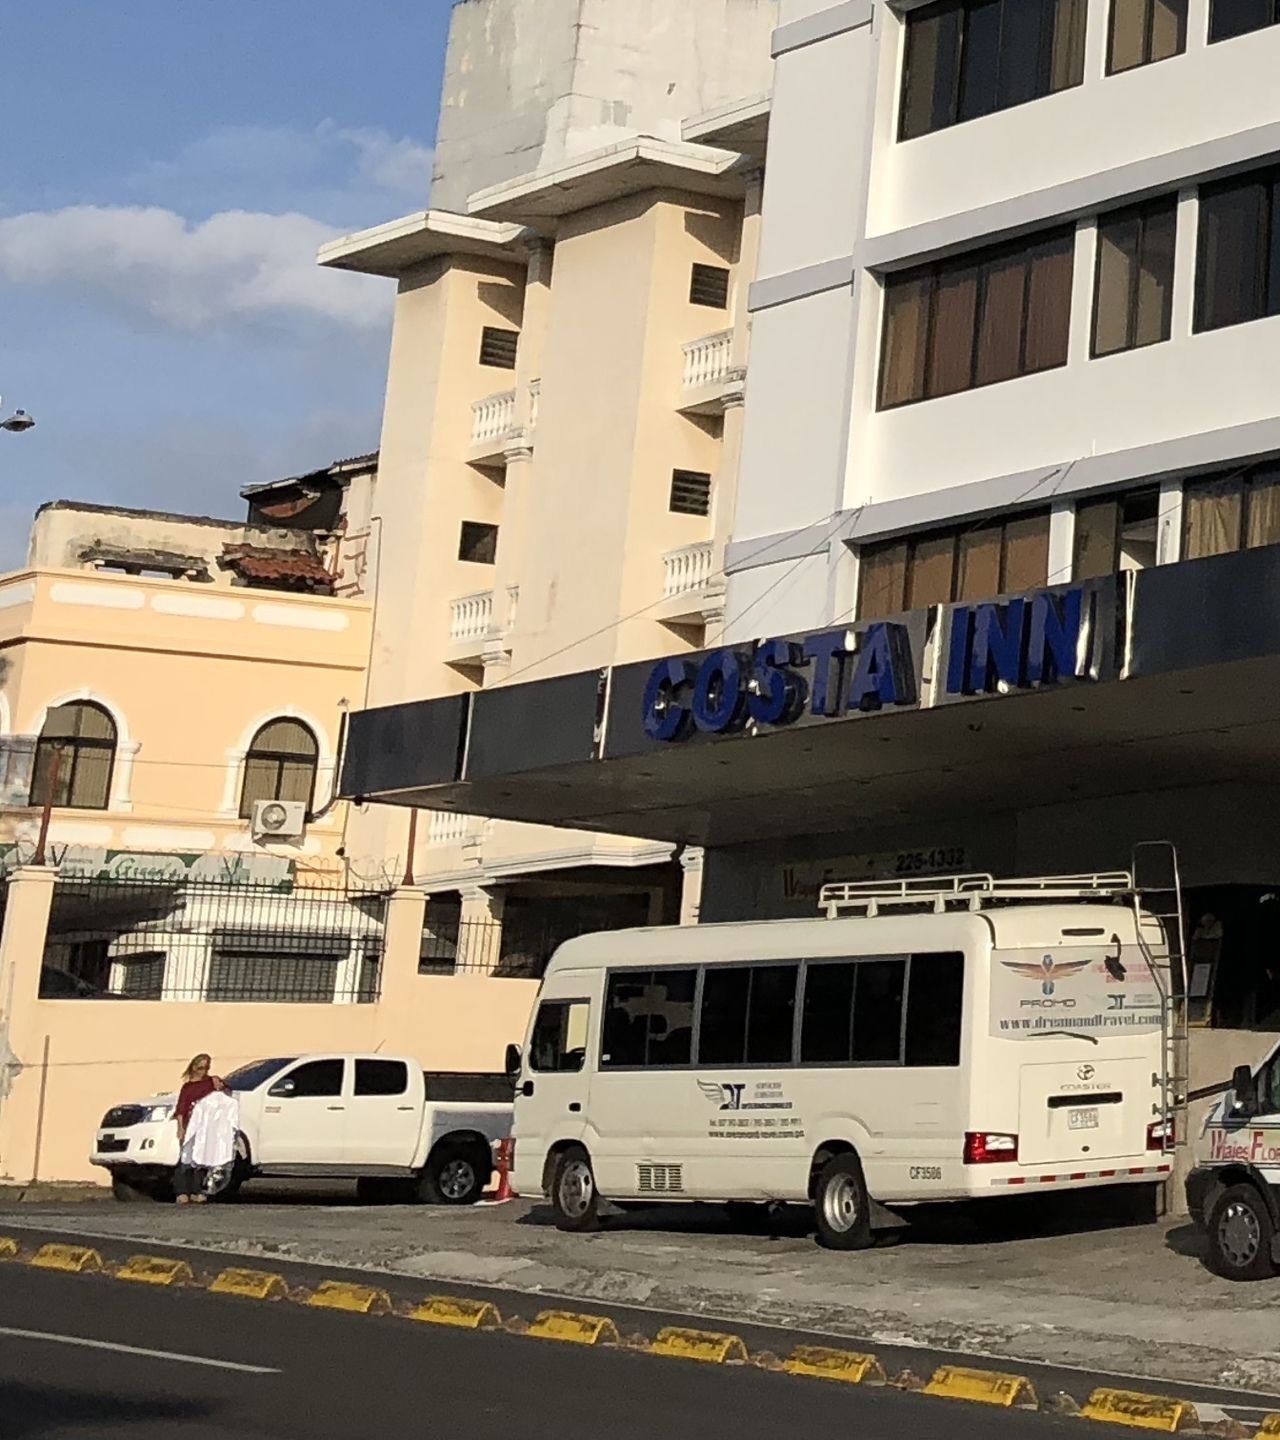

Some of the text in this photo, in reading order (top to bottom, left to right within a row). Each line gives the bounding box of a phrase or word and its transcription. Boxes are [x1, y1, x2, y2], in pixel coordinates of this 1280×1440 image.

[642, 589, 1083, 741] COSTA INN
[1020, 999, 1077, 1009] PROMO
